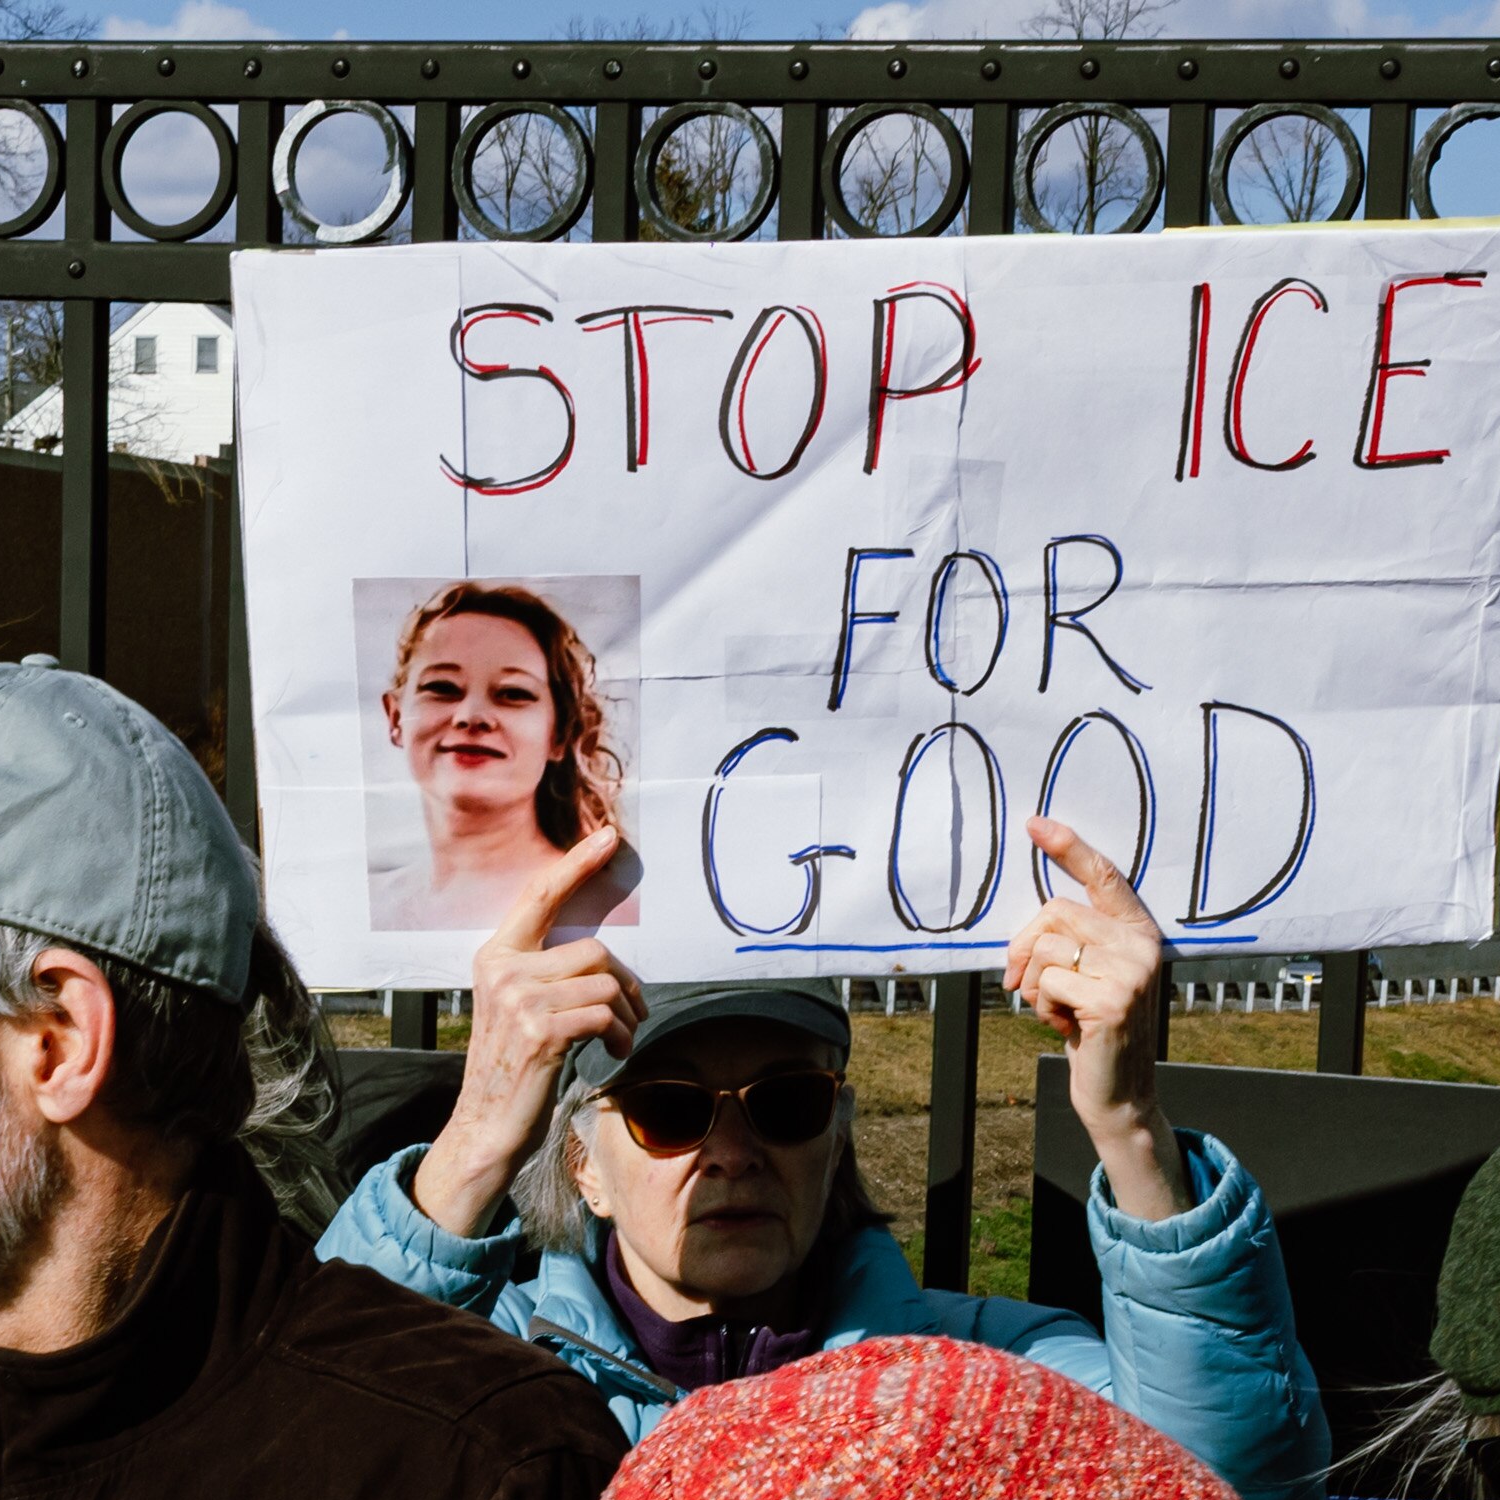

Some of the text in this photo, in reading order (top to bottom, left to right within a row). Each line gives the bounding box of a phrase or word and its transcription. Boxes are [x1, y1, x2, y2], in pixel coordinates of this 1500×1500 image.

[440, 270, 1488, 496] STOP ICE
[827, 533, 1153, 712] FOR
[701, 700, 1317, 937] GOOD
